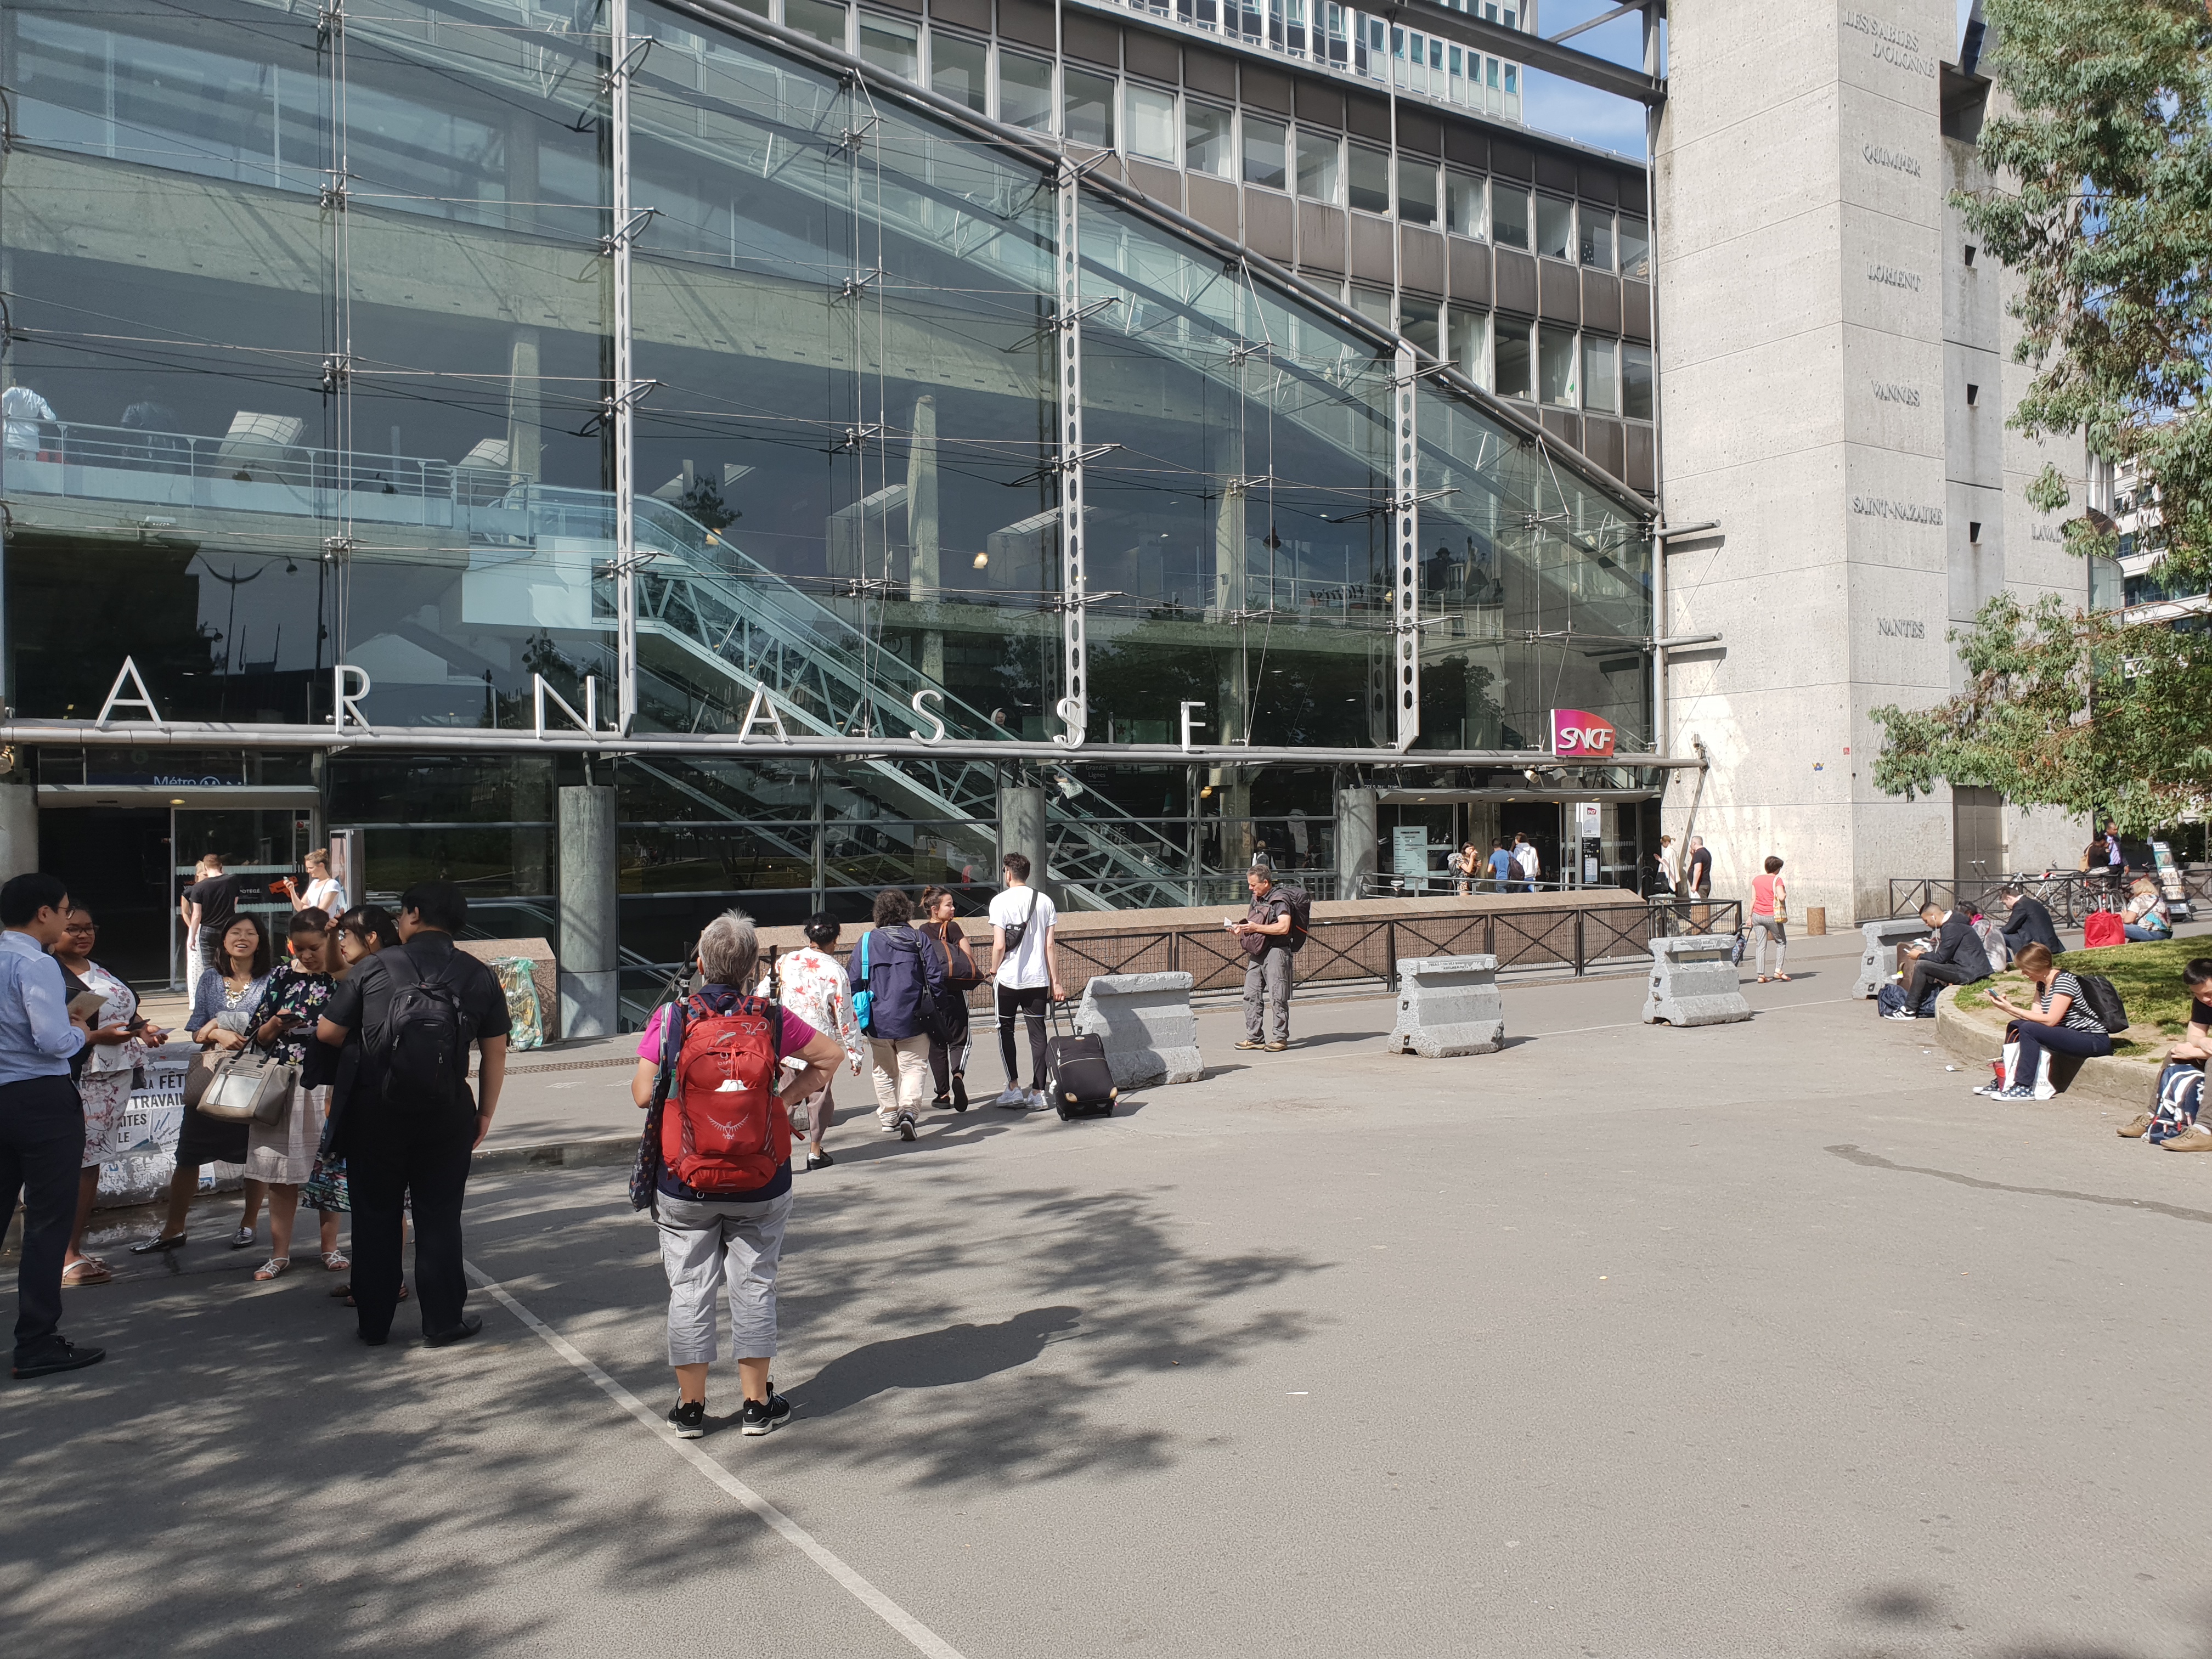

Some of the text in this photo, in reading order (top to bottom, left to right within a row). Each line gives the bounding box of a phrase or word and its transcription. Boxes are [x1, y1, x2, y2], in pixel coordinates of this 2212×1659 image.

[1845, 9, 1919, 53] LES SABLES
[1862, 143, 1921, 178] QUIMPER
[1866, 262, 1921, 292] LORIENT
[1870, 380, 1920, 408] VANNES
[1852, 494, 1943, 526] SAINT-NAZAIRE
[1876, 617, 1925, 640] NANTES
[1558, 727, 1613, 749] SNCF
[159, 1070, 187, 1089] FÊT
